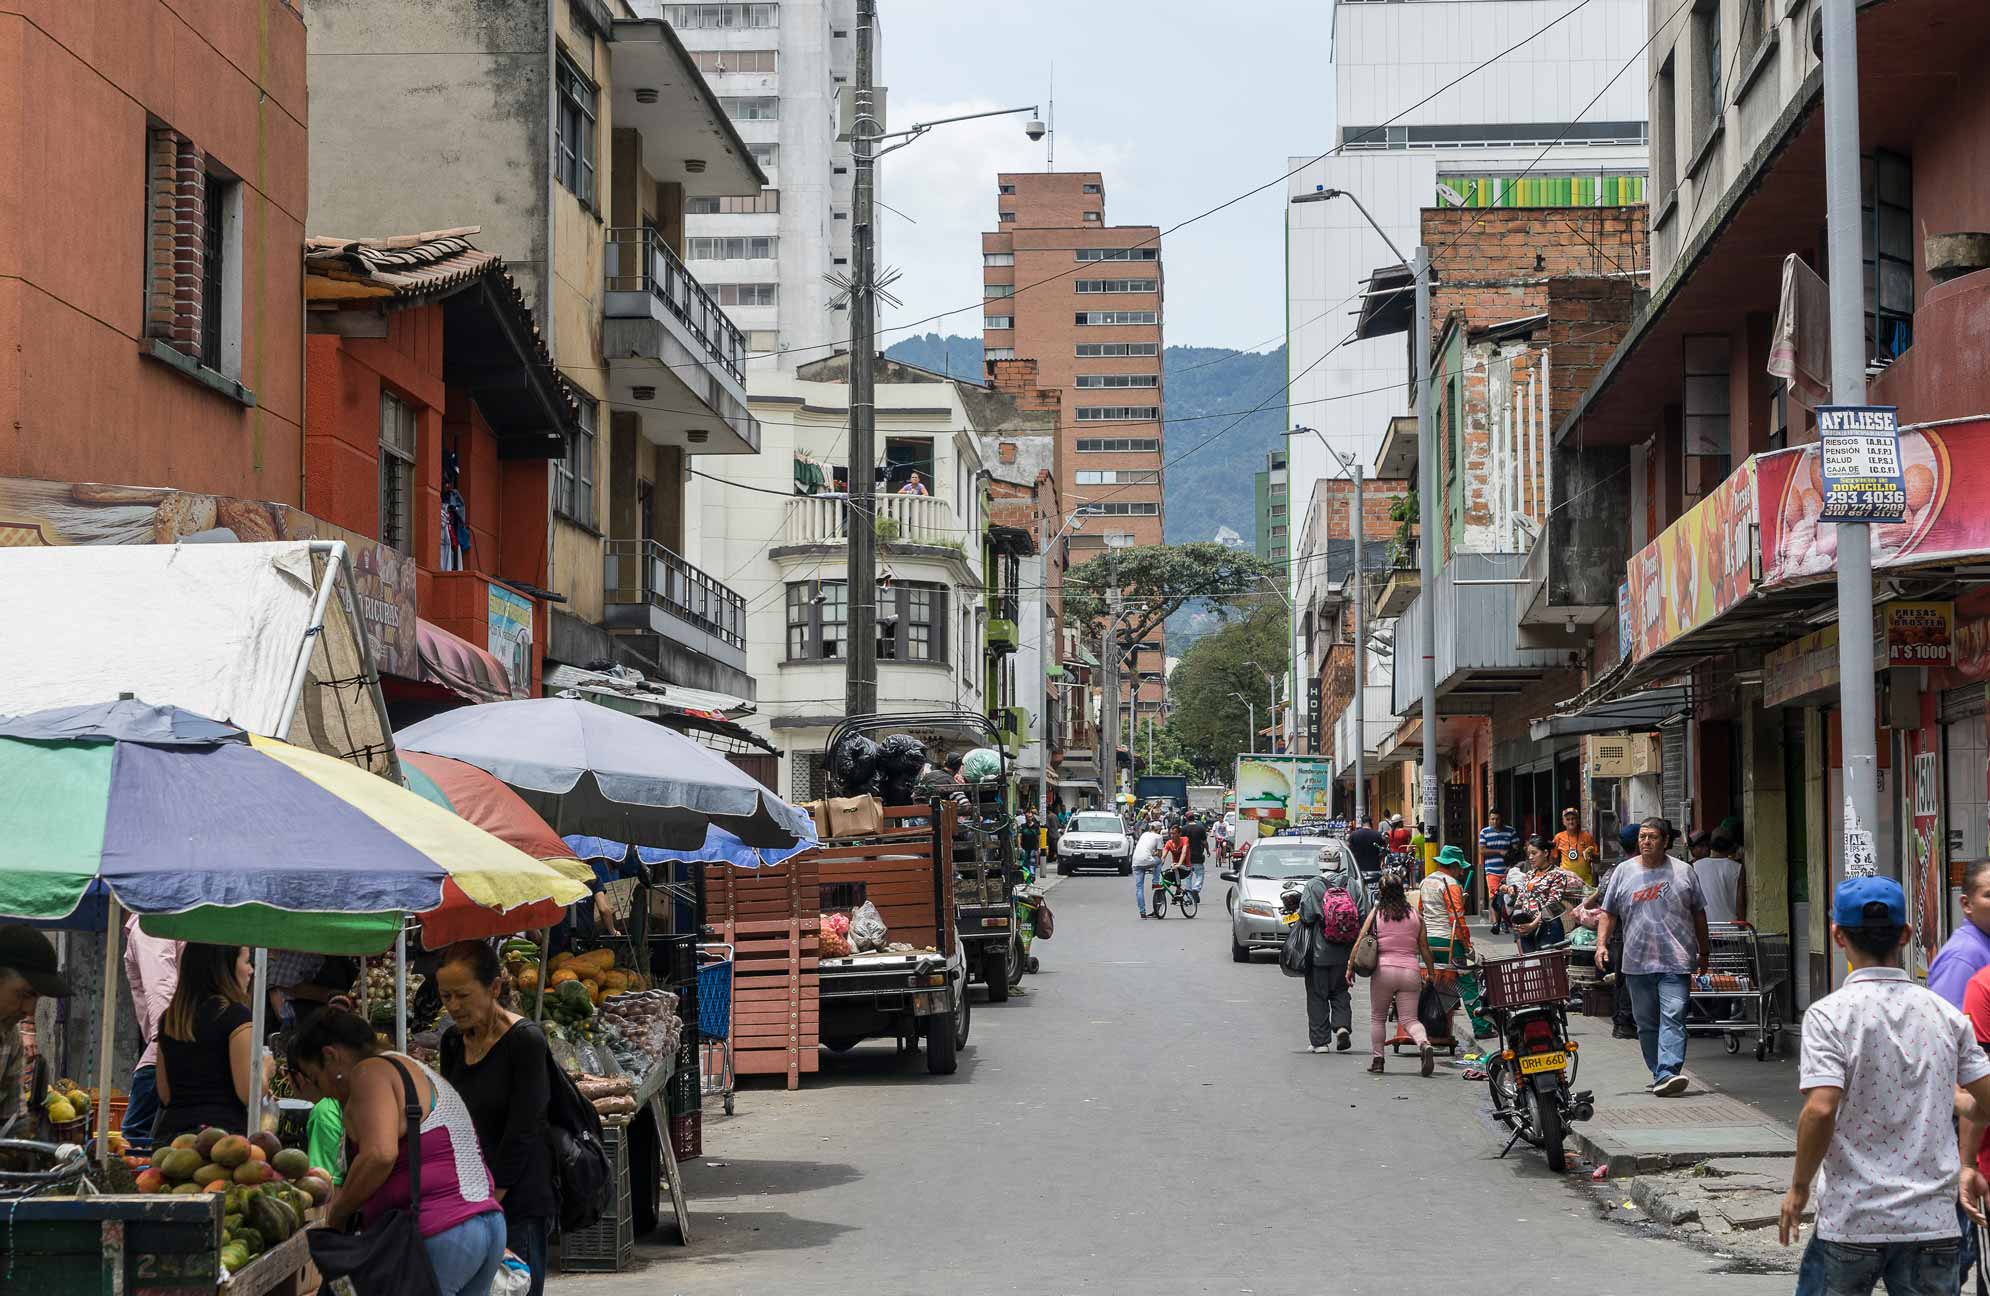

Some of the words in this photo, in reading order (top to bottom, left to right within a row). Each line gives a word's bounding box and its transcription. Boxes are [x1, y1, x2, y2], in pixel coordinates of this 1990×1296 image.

[1822, 411, 1894, 430] AFILIESE
[1825, 438, 1859, 446] RIESGOS
[1825, 446, 1860, 455] PENSIÓN
[1832, 483, 1897, 491] DOMICILIO
[1826, 491, 1858, 503] 293
[1862, 491, 1905, 503] 4036
[1826, 503, 1848, 511] 300
[1876, 503, 1905, 511] 7208
[365, 597, 399, 628] RICURAS
[1895, 609, 1937, 617] PRESAS
[1310, 687, 1318, 746] HOTEL
[1915, 756, 1936, 813] 1500
